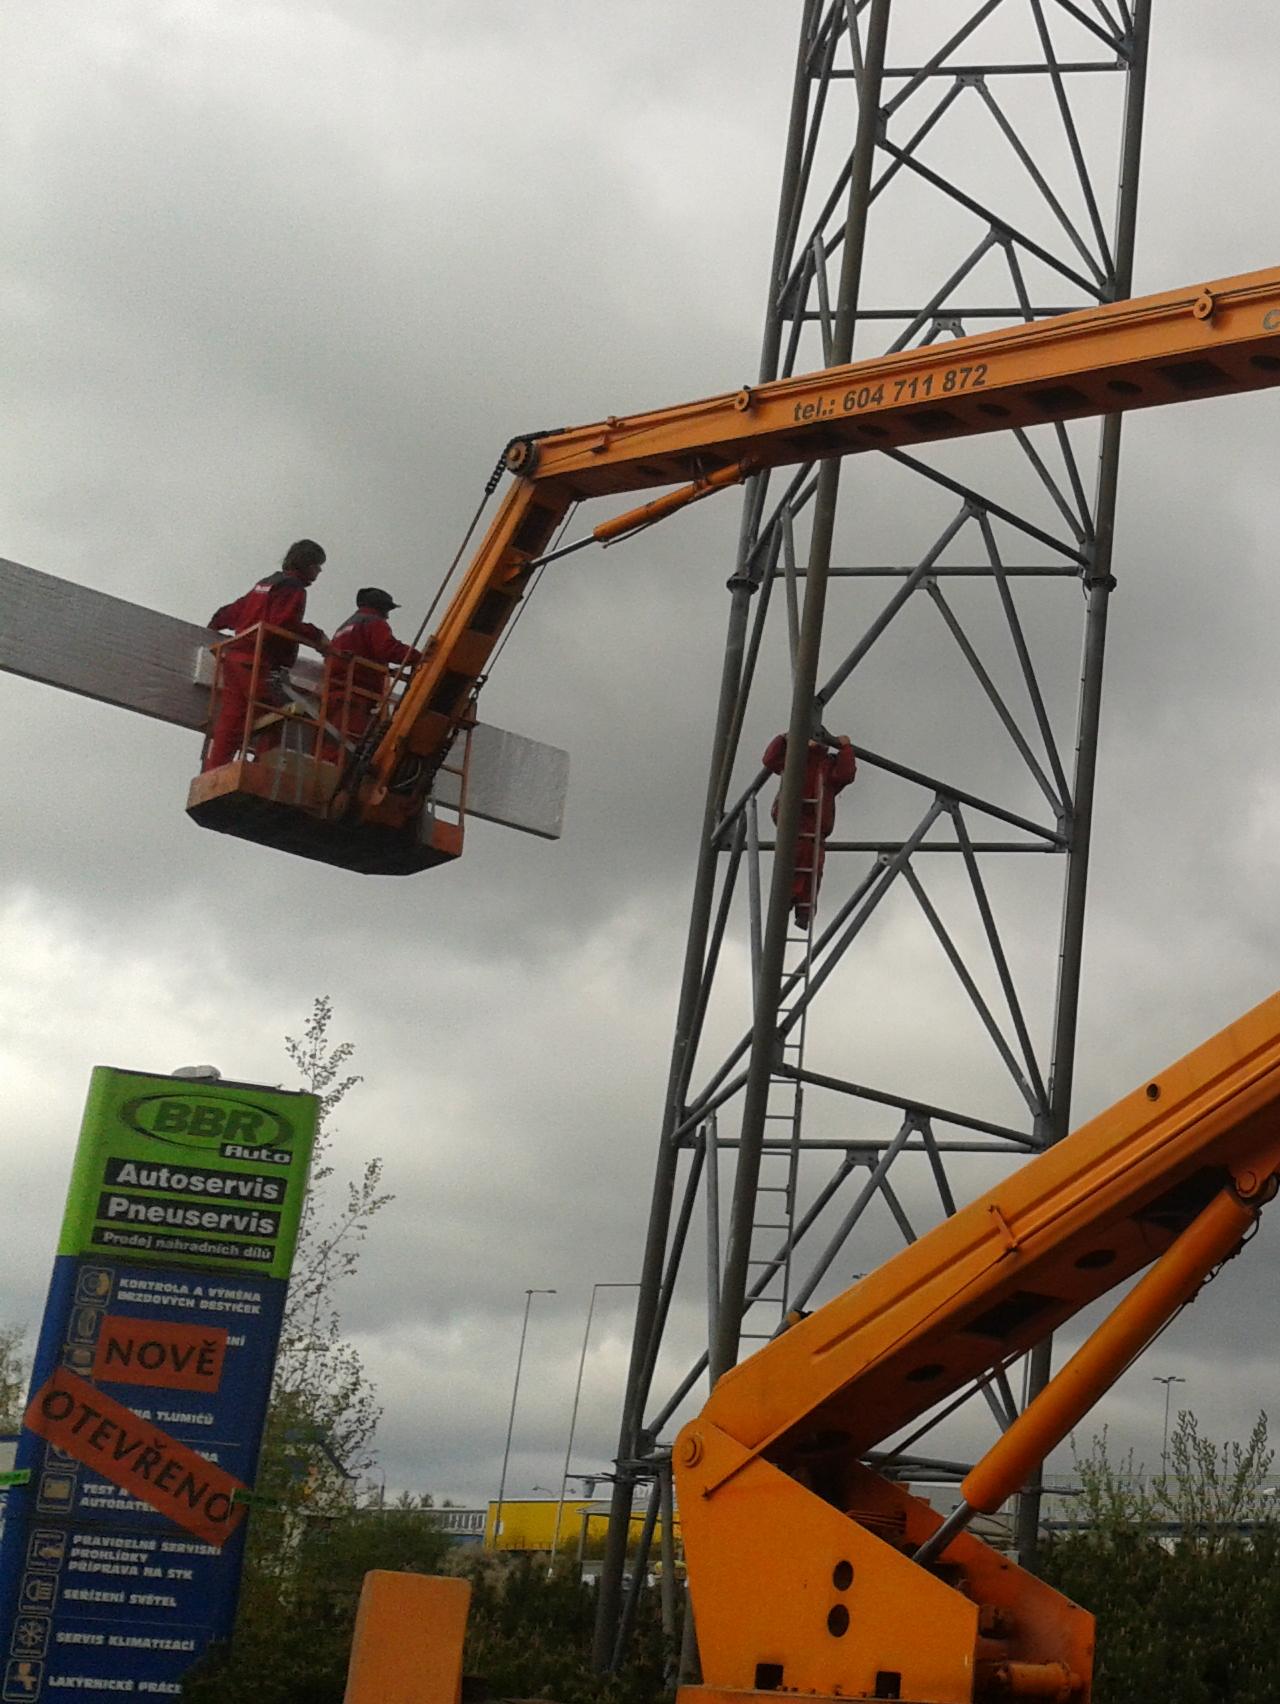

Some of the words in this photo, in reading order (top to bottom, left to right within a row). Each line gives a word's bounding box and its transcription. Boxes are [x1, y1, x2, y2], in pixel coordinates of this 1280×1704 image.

[794, 397, 835, 422] tel.:
[843, 383, 885, 412] 604
[894, 374, 934, 402] 711
[942, 364, 988, 393] 872
[153, 1101, 265, 1143] BBR
[224, 1144, 291, 1164] Auto
[116, 1163, 280, 1199] Autoservis
[107, 1197, 275, 1234] Pneuservis
[103, 1231, 153, 1249] Prodej
[119, 1279, 189, 1295] KONTROLA
[193, 1286, 204, 1296] A
[208, 1286, 262, 1302] VÝMĚNA
[117, 1290, 196, 1308] BRZDOVÝCH
[200, 1299, 262, 1315] DESTIČEK
[41, 1390, 235, 1523] OTEVŘENO
[82, 1483, 115, 1496] TEST
[70, 1547, 149, 1564] PROHLÍDKY
[72, 1534, 157, 1551] PRAVIDELNÉ
[160, 1541, 223, 1556] SERVISNÍ
[68, 1560, 140, 1577] PŘÍPRAVA
[144, 1567, 163, 1579] NA
[167, 1568, 193, 1581] STK
[63, 1588, 126, 1604] SEŘÍZENÍ
[128, 1593, 178, 1608] SVĚTEL
[55, 1631, 104, 1646] SERVIS
[108, 1634, 195, 1652] KLIMATIZACÍ
[48, 1674, 134, 1692] LAKÝRNICKÉ
[138, 1681, 183, 1695] PRÁCE
